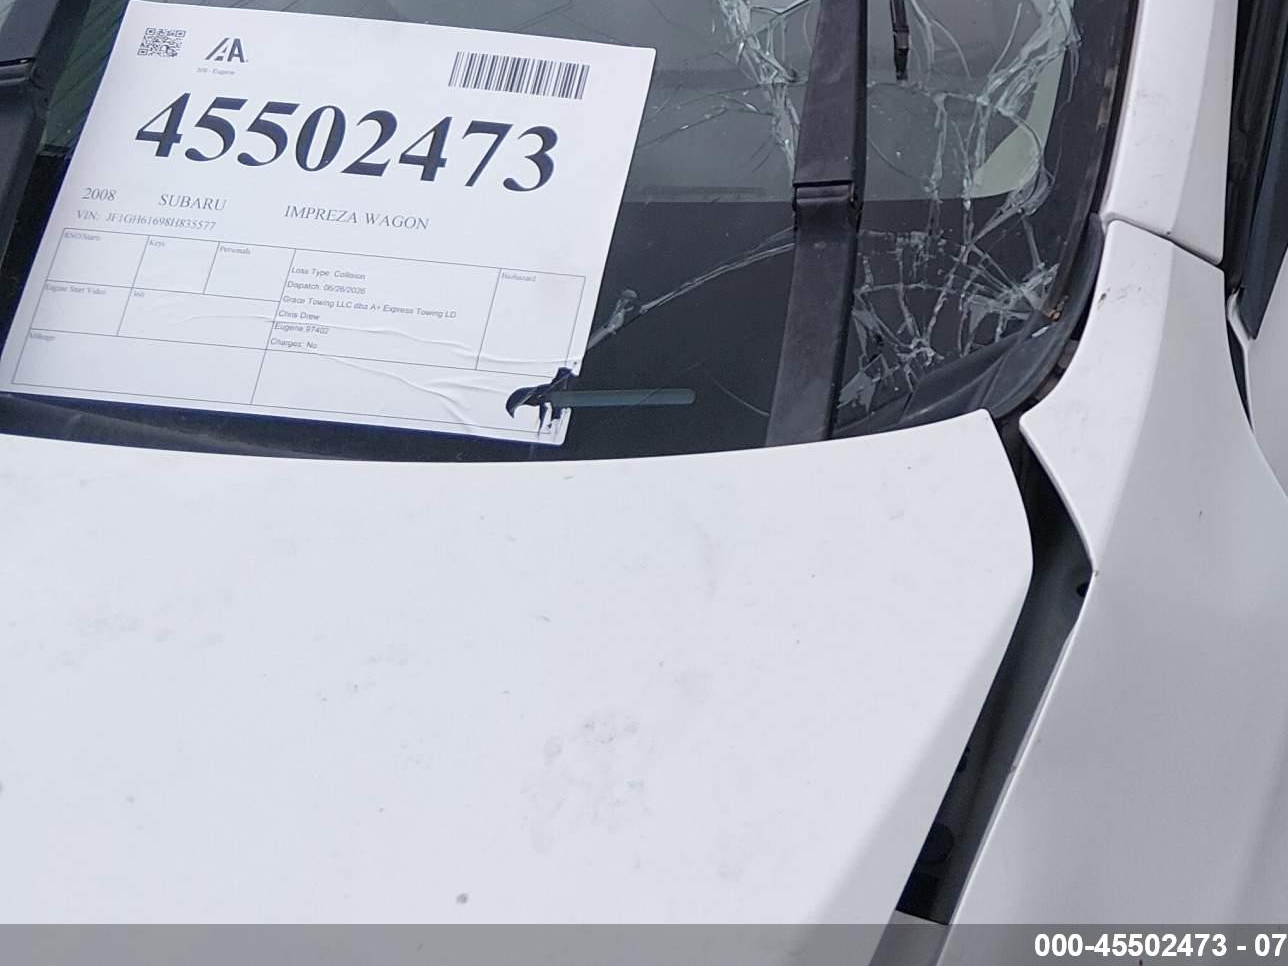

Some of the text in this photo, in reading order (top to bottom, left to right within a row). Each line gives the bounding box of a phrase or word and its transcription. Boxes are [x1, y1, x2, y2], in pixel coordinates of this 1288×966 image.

[135, 92, 559, 192] 45502473
[77, 209, 99, 221] VIN:
[82, 187, 430, 230] 2008 SUBARU IMPREZA WAGON
[291, 266, 309, 274] Loss
[334, 270, 366, 280] Collision
[283, 295, 305, 304] Grace
[308, 297, 335, 308] Towing
[336, 300, 352, 308] LLC
[383, 304, 414, 314] Express
[417, 307, 443, 318] Towing
[278, 310, 298, 318] Chris
[306, 341, 318, 349] No
